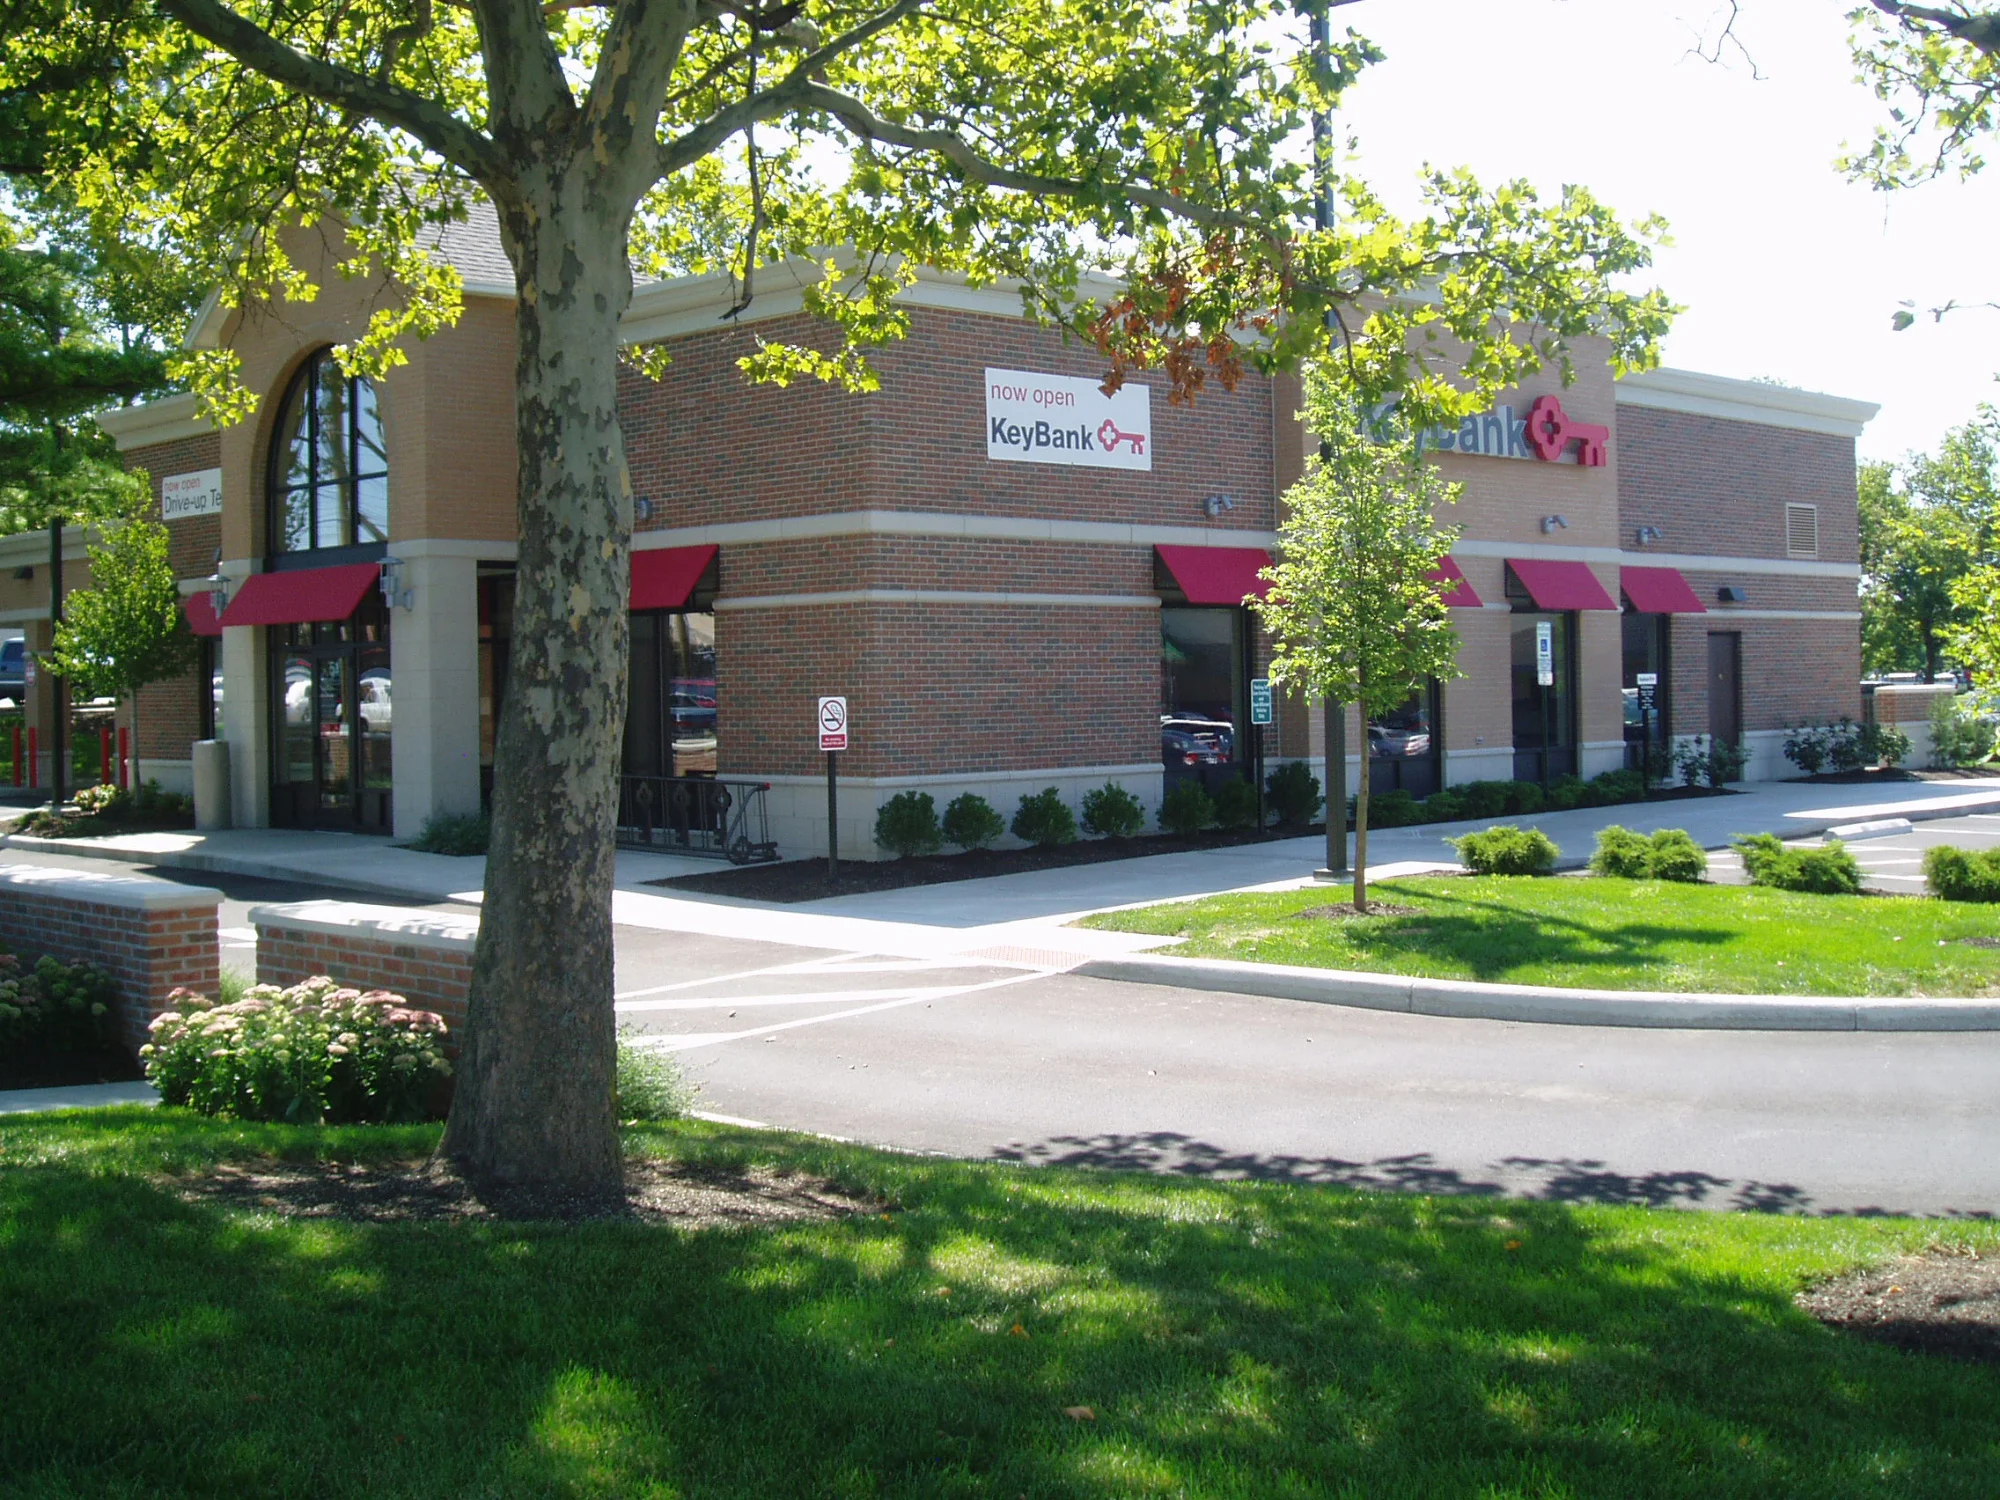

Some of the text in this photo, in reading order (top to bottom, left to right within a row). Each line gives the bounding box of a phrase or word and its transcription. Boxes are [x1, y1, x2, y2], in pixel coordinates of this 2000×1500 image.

[991, 384, 1075, 408] now open
[991, 417, 1094, 452] KeyBank
[181, 478, 201, 491] open
[165, 495, 207, 513] Drive-up
